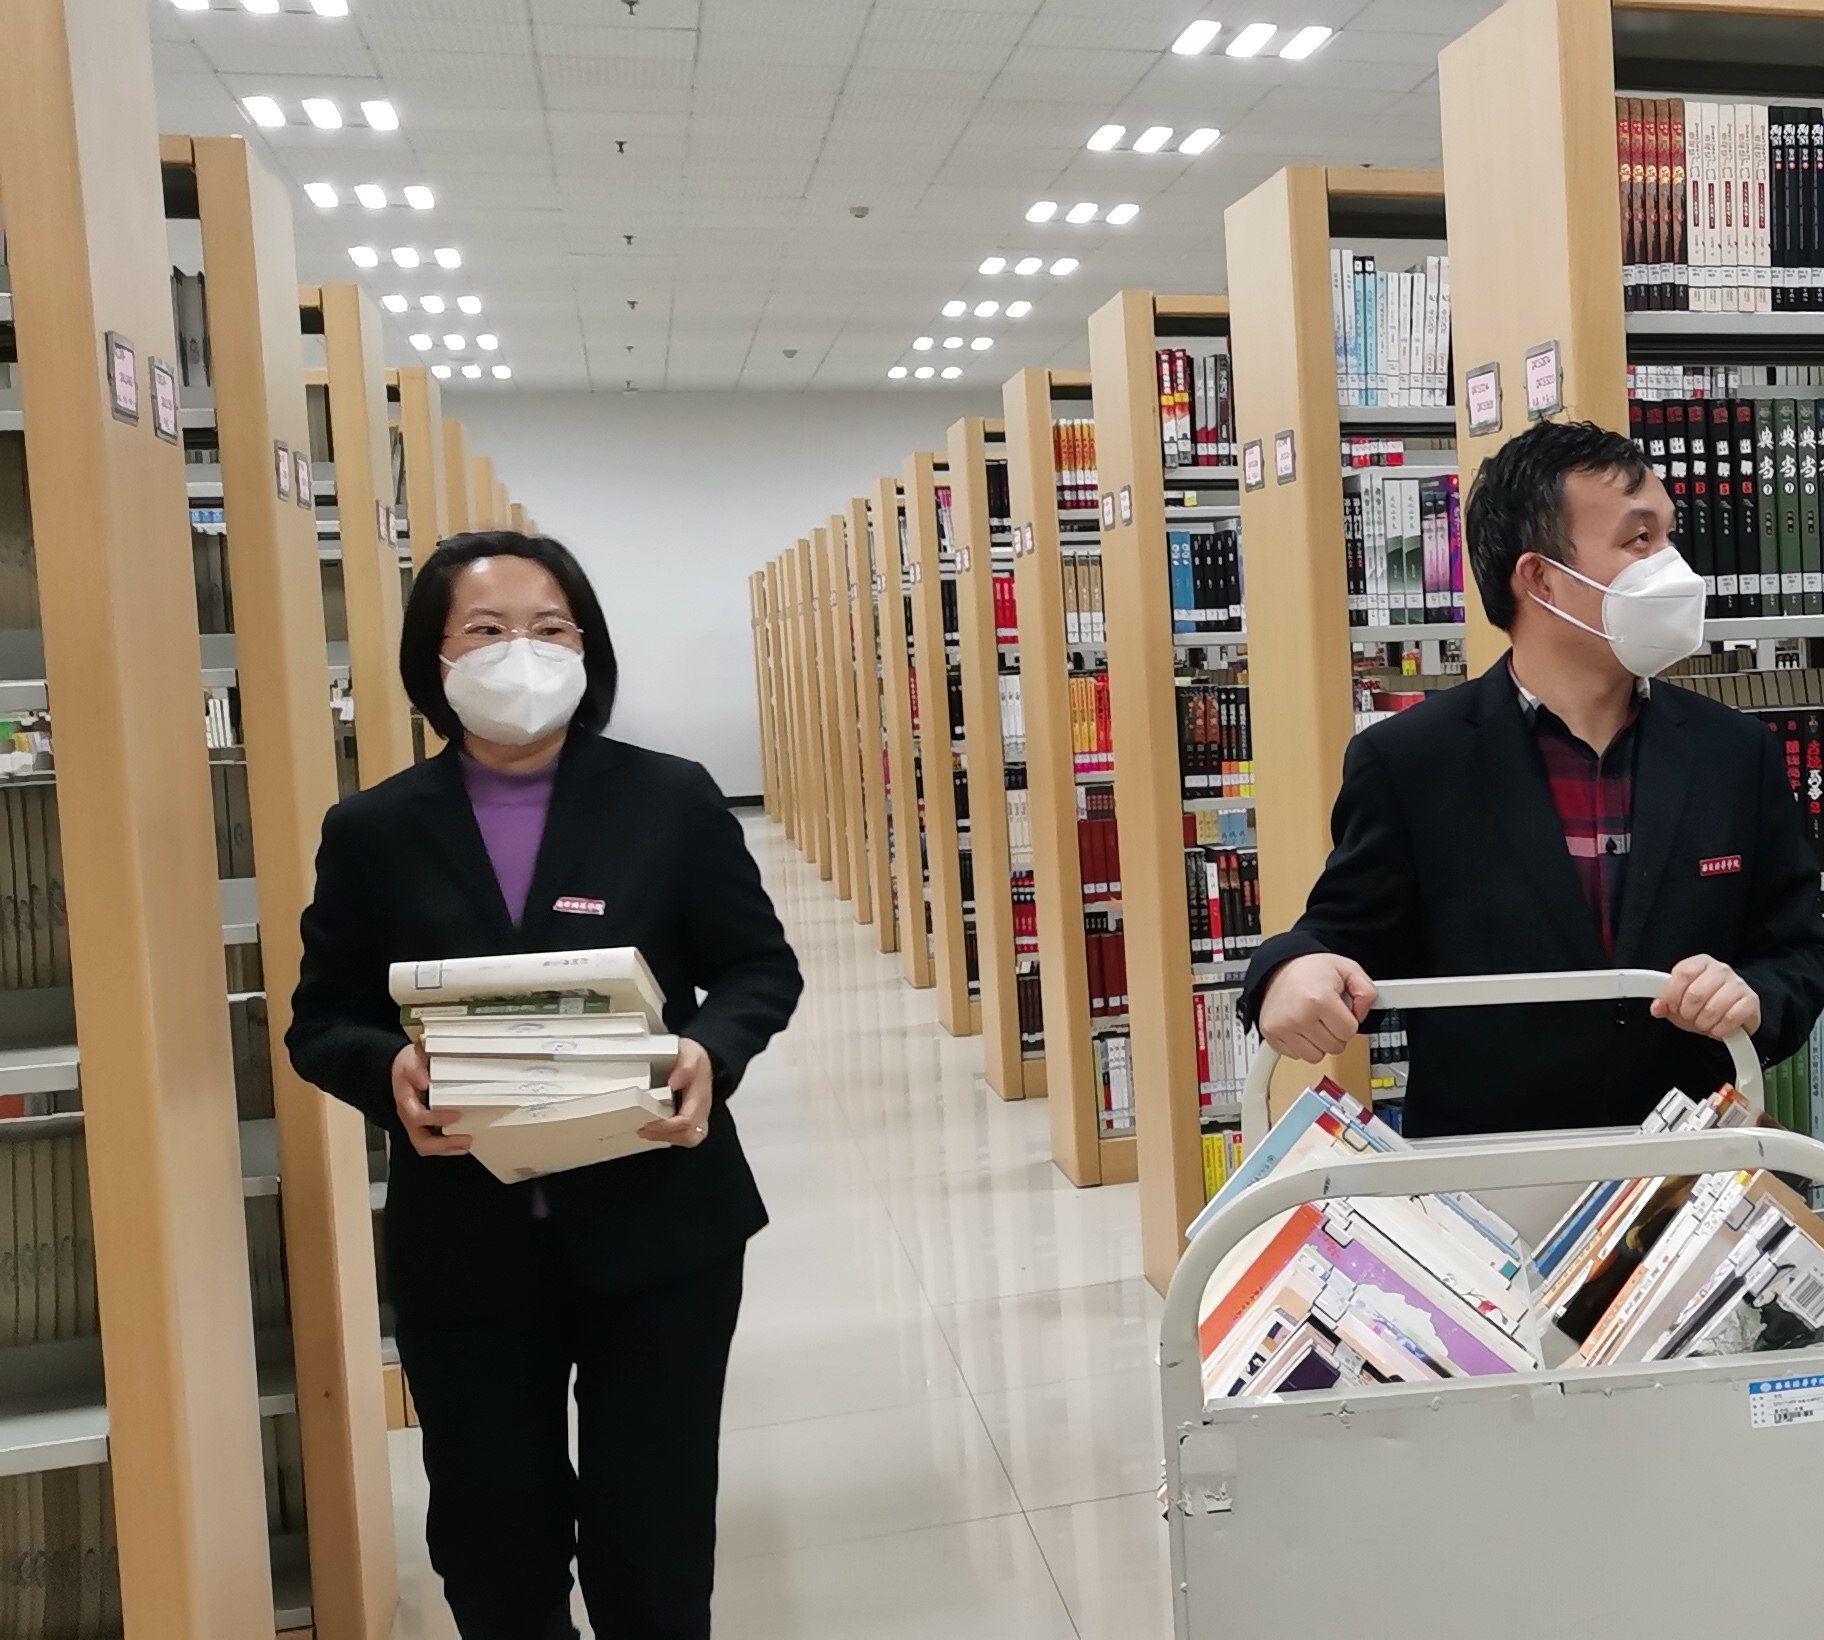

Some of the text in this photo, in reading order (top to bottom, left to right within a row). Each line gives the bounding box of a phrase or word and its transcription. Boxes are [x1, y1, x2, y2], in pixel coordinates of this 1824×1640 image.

[1757, 426, 1774, 480] 典当
[1779, 424, 1797, 479] 典当
[1799, 425, 1817, 480] 典当
